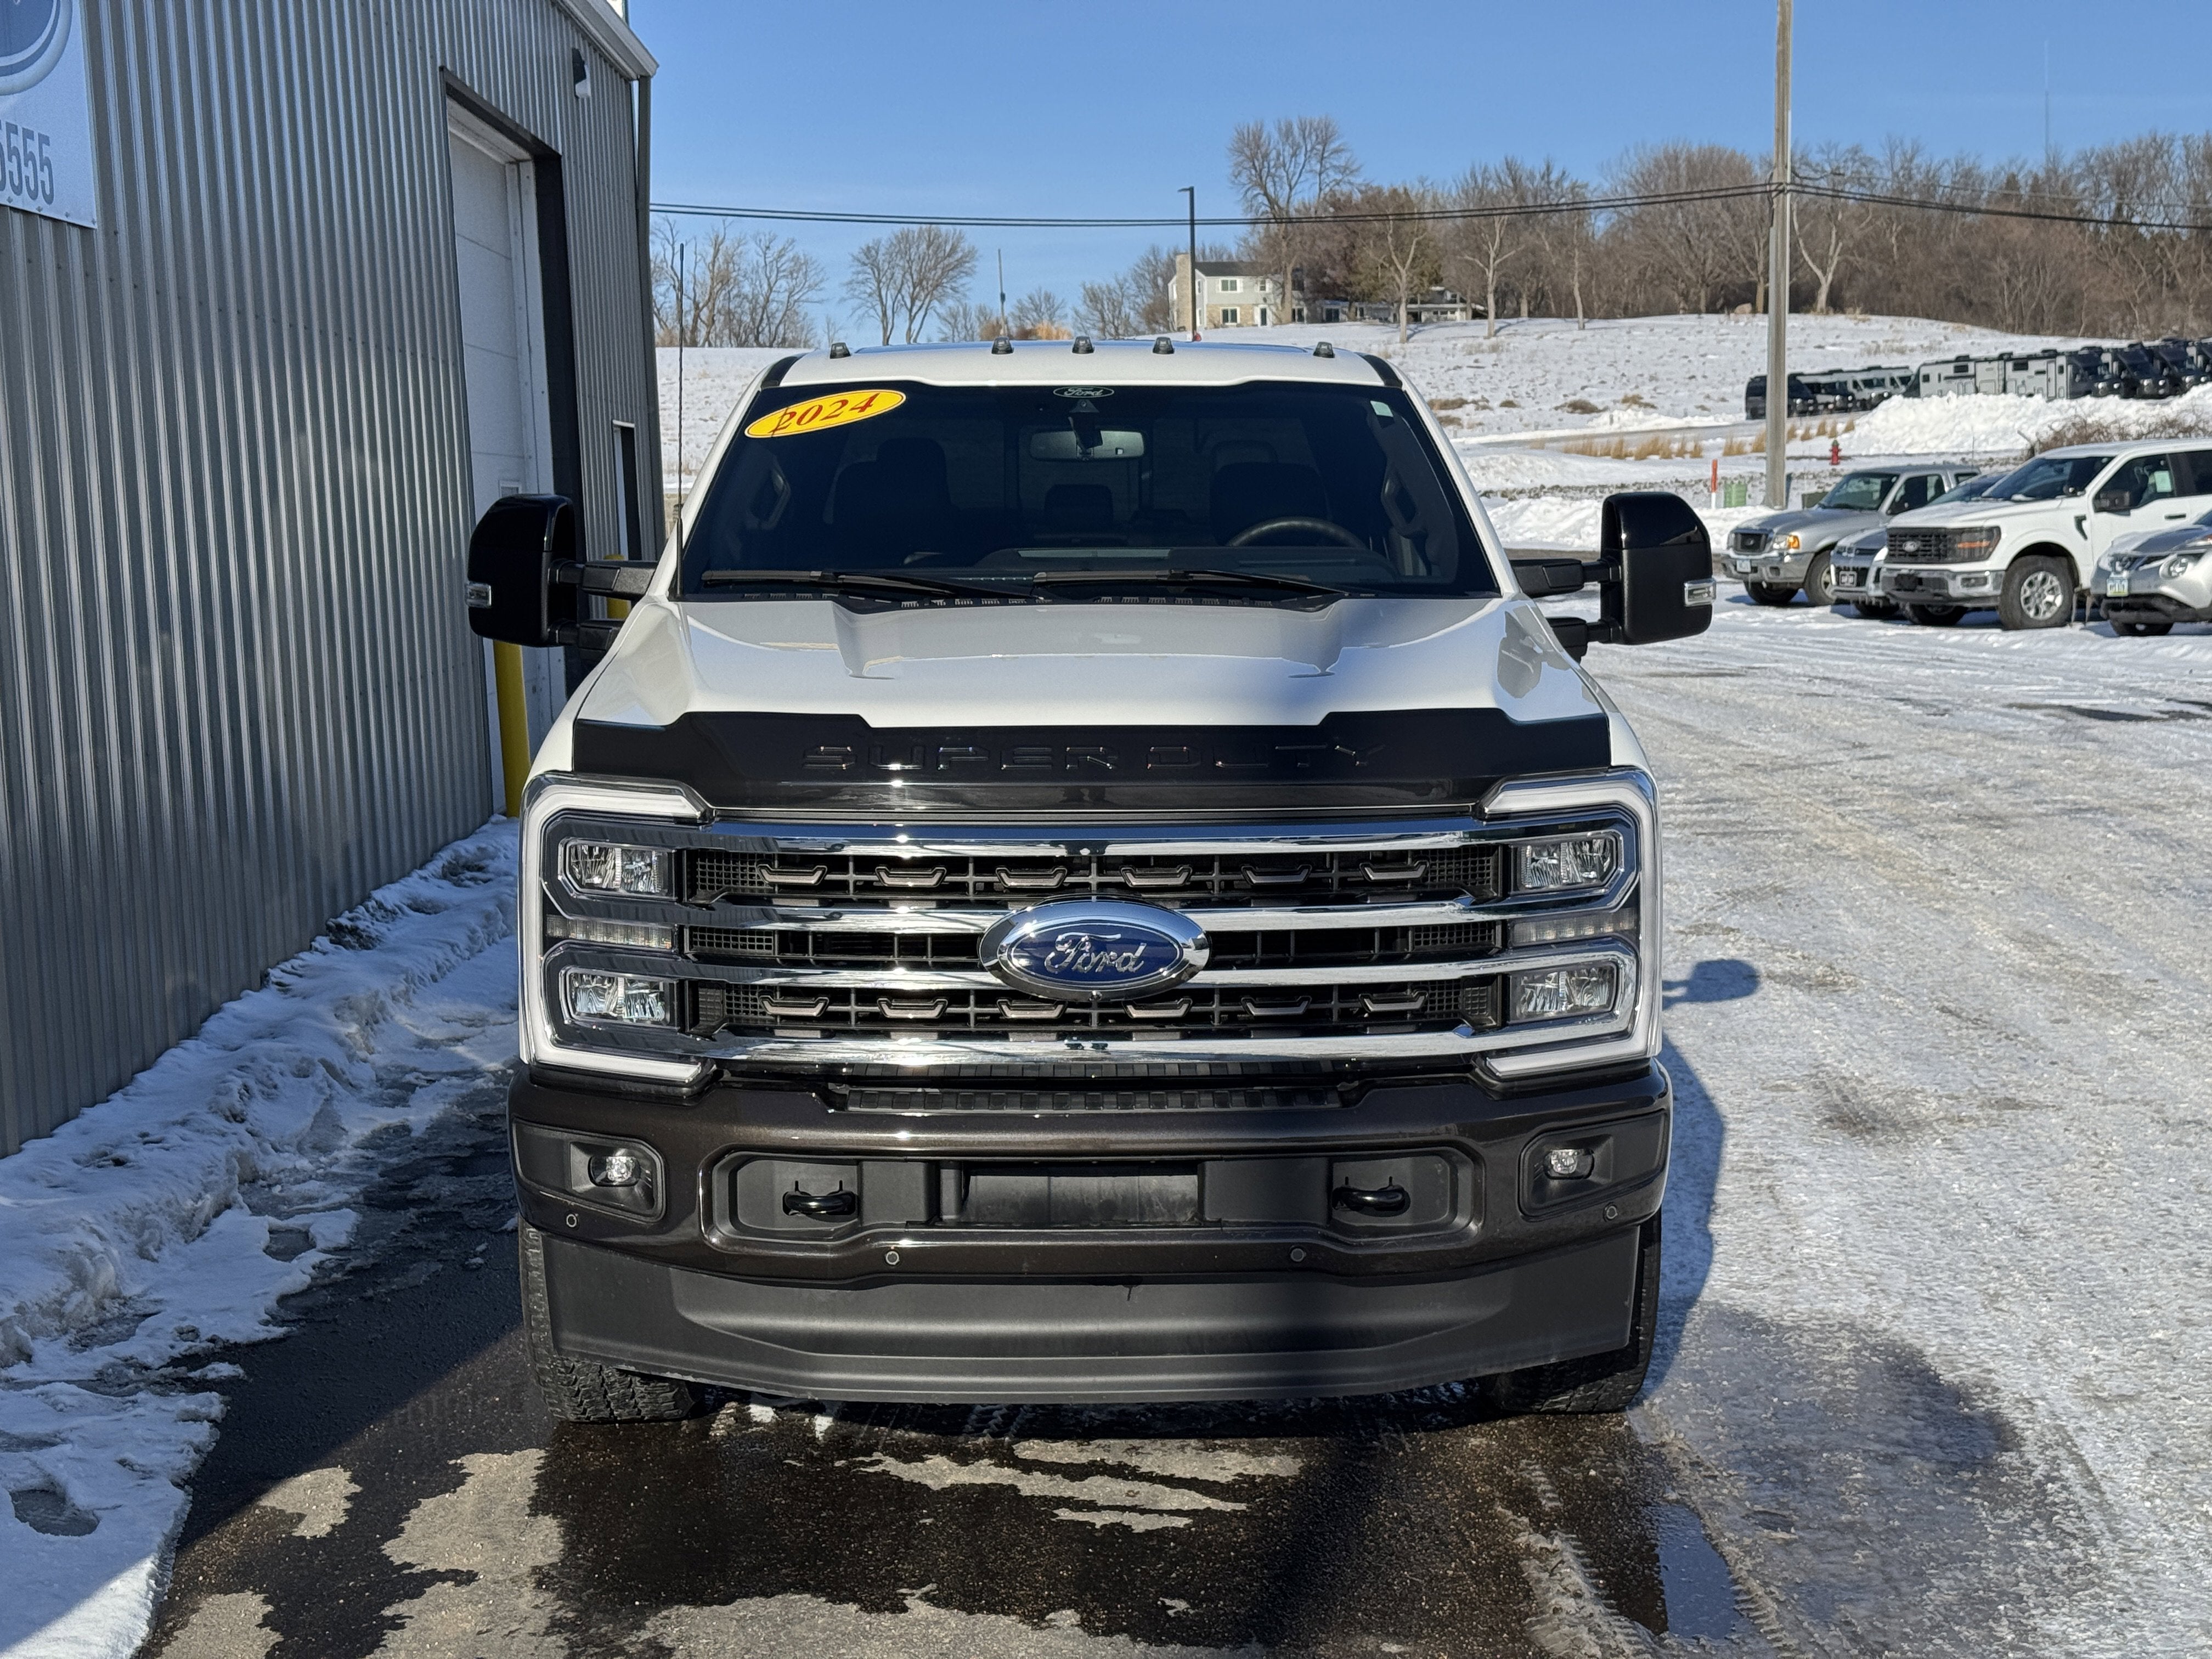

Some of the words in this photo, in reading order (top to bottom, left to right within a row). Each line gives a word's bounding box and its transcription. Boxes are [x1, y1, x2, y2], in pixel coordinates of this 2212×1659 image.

[1064, 387, 1103, 396] Ford
[768, 393, 881, 434] 2024
[803, 744, 1119, 770] SUPER
[1146, 743, 1386, 770] DUTY
[1044, 932, 1147, 974] Ford
